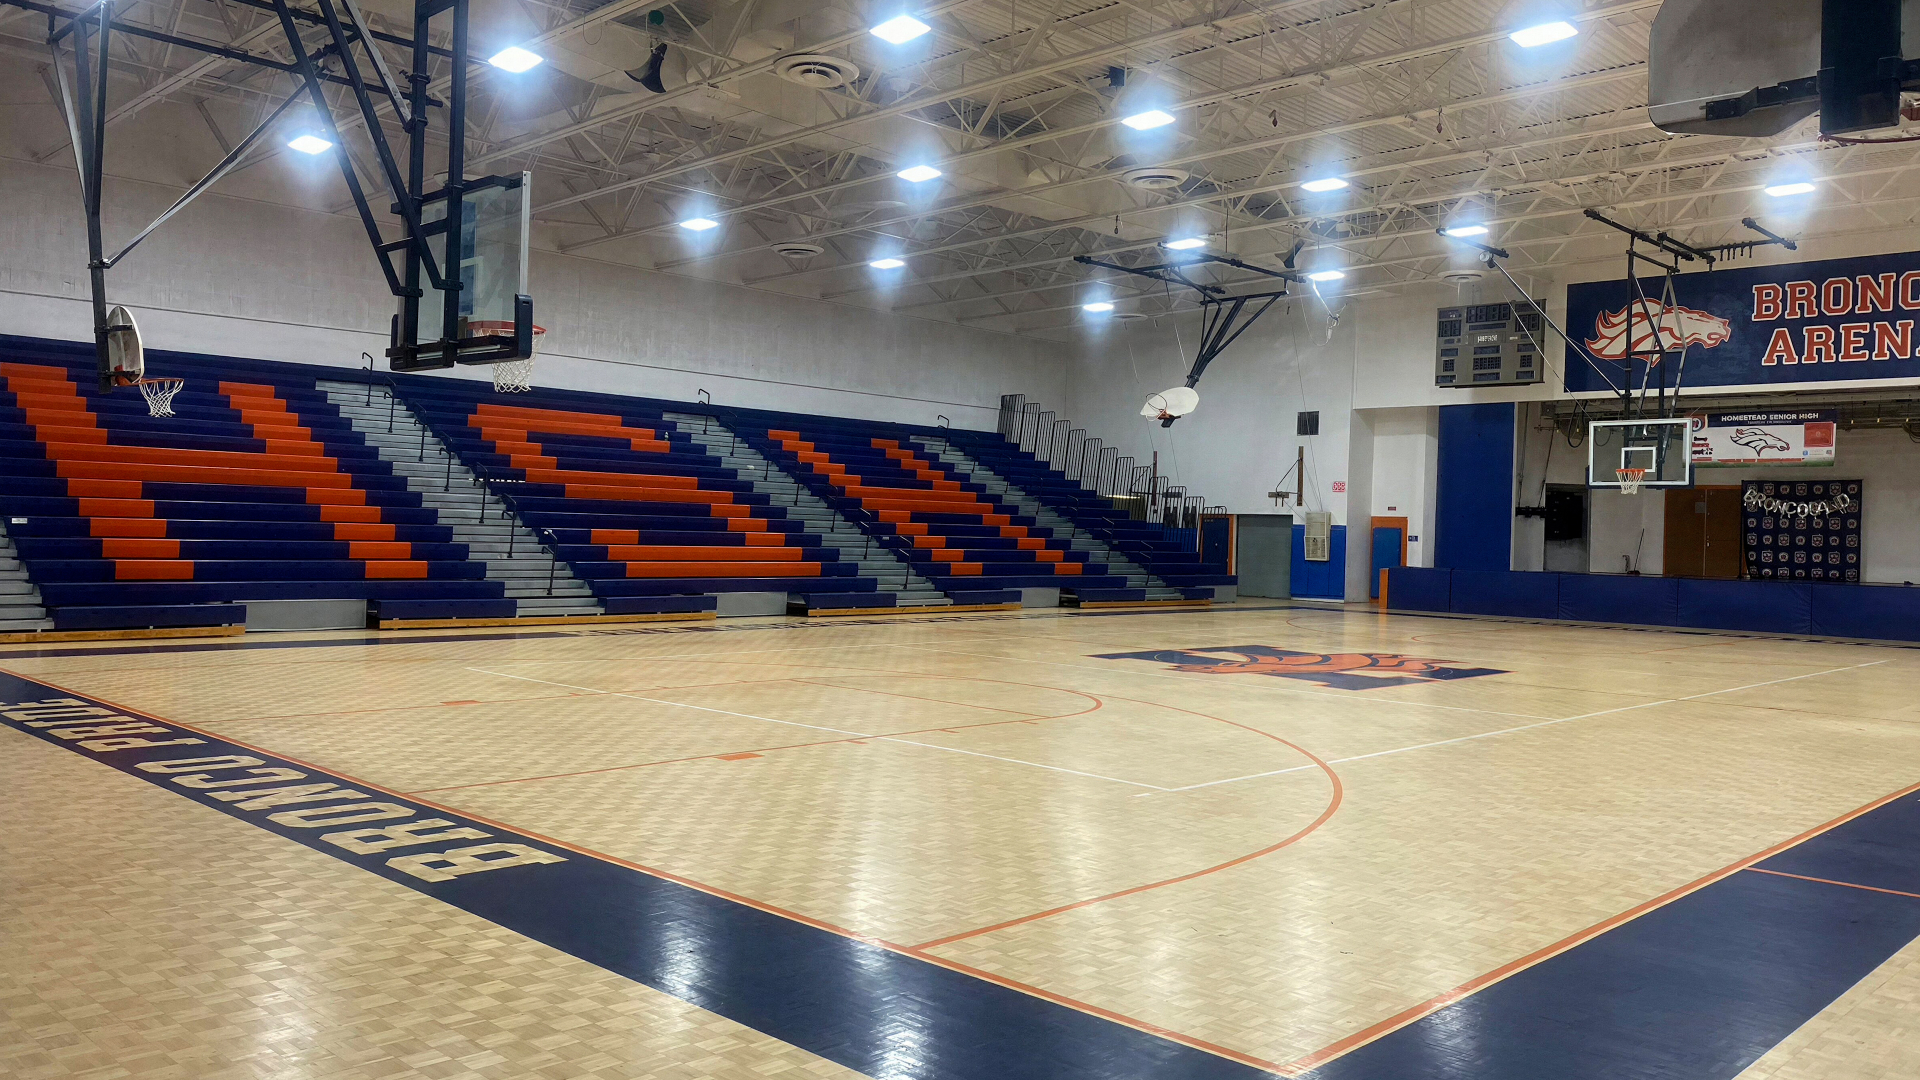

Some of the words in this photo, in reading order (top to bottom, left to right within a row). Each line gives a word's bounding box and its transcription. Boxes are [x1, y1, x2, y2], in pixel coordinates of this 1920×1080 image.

[1762, 320, 1920, 366] AREN
[1721, 414, 1767, 422] HOMESTEAD
[0, 697, 208, 753] PRIDE
[133, 754, 569, 884] BRONCO
